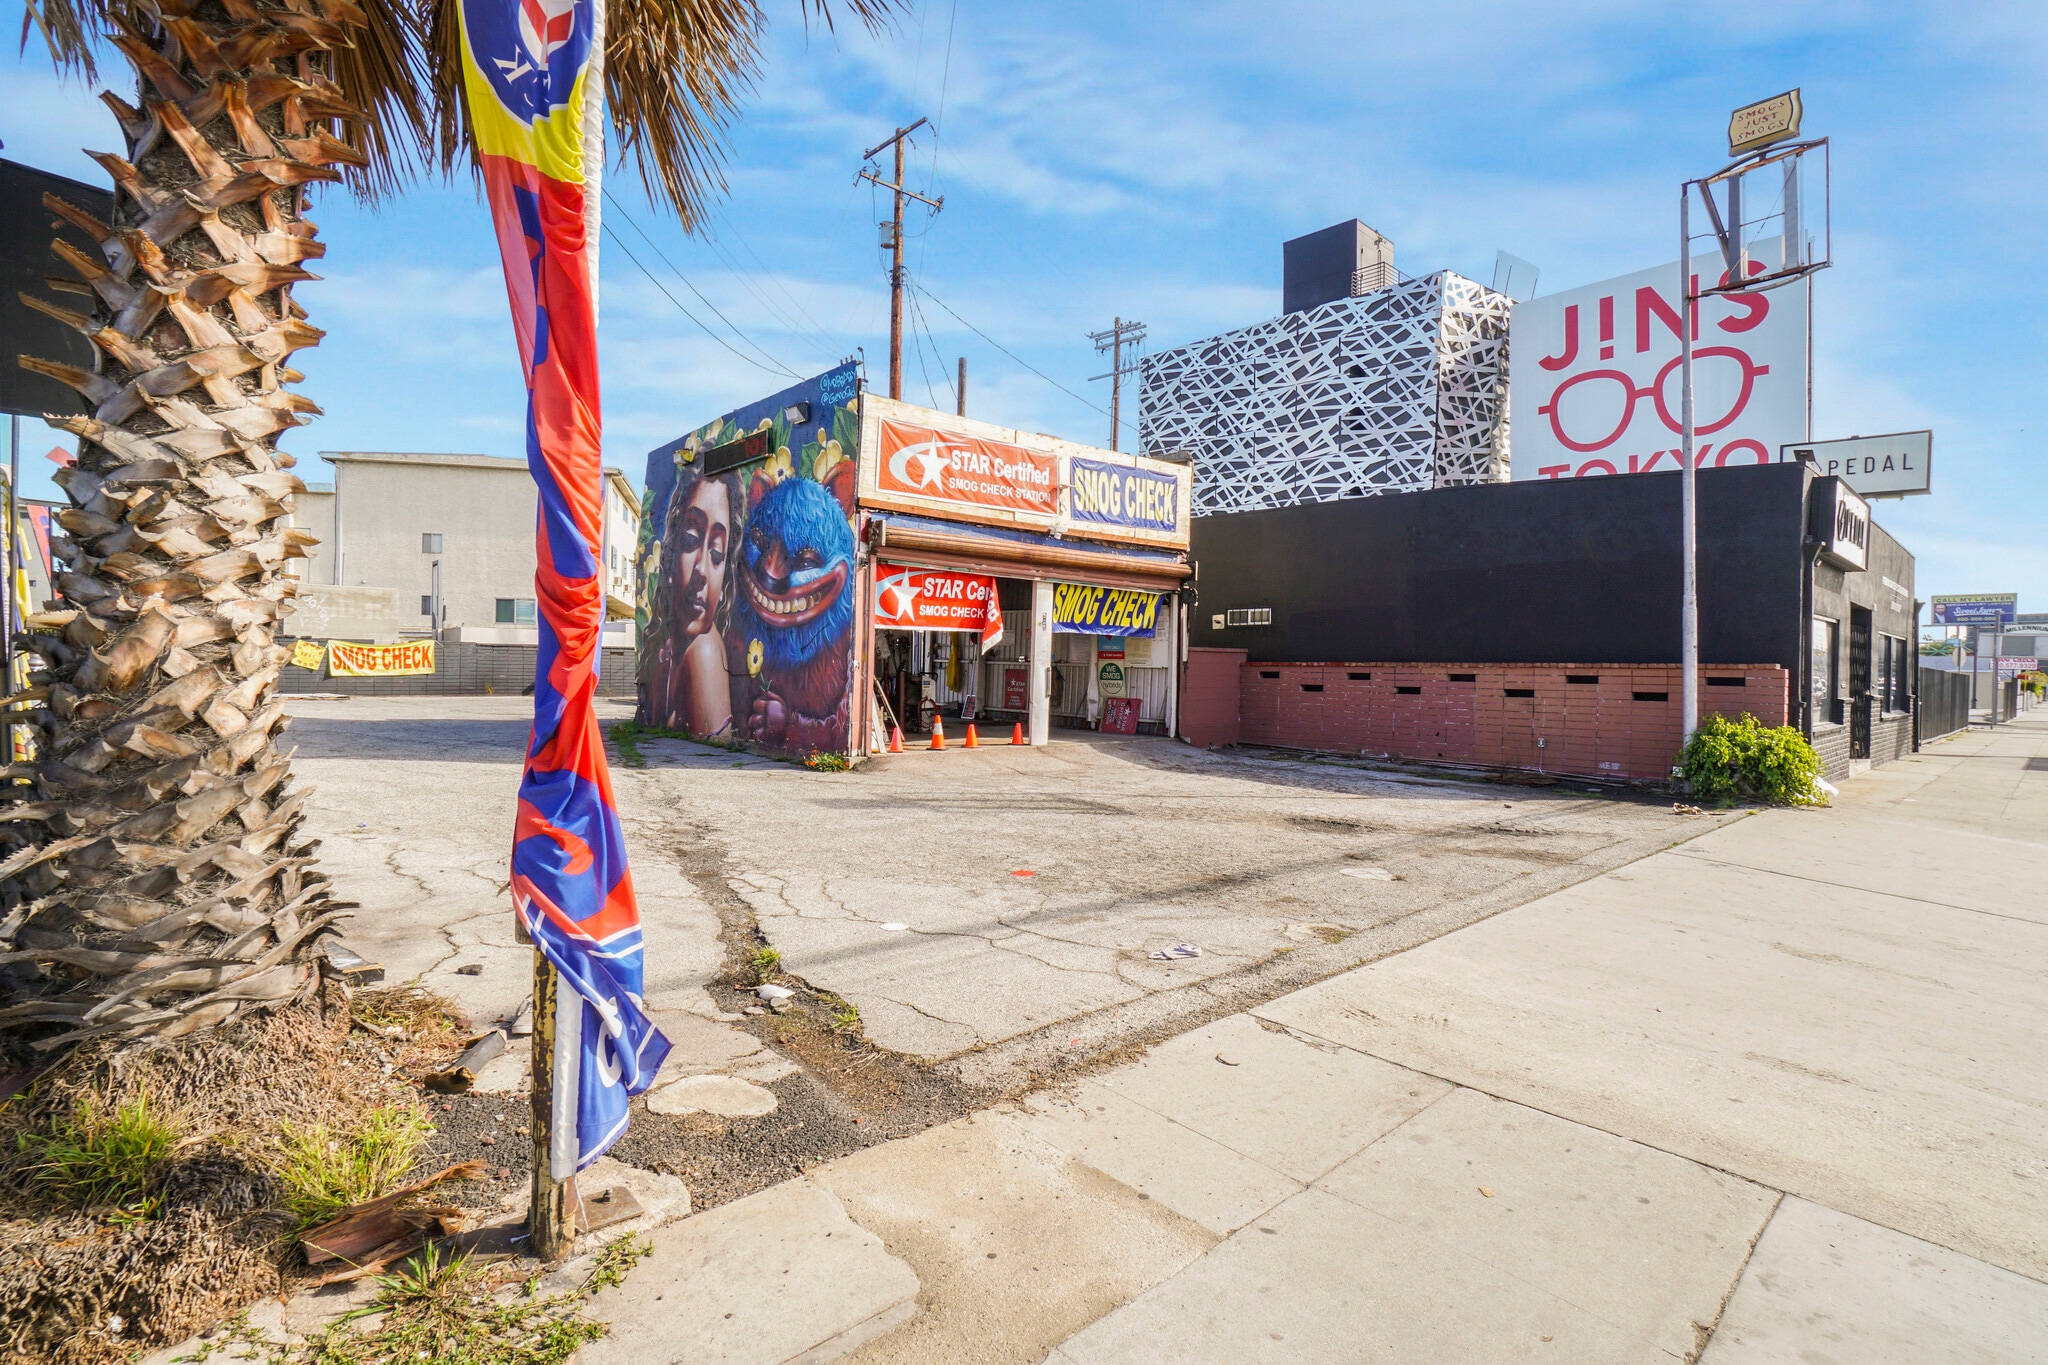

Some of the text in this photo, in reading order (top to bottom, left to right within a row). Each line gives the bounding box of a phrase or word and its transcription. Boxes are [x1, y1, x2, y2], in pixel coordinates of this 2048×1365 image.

[1738, 100, 1785, 122] SMOGS
[1744, 111, 1778, 129] JUST
[1737, 119, 1784, 141] SMOGS
[951, 449, 1050, 485] STAR Certified
[1828, 453, 1914, 477] PEDAL
[949, 477, 1051, 503] SMOG CHECK STATION
[1074, 467, 1175, 523] SMOG CHECK
[923, 577, 965, 600] STAR
[920, 604, 949, 617] SMOG
[950, 606, 985, 619] CHECK
[1053, 583, 1105, 625] SMOG
[1100, 589, 1160, 629] CHECK
[333, 645, 377, 671] SMOG
[381, 645, 433, 671] CHECK
[1106, 665, 1116, 673] WE
[1102, 672, 1121, 680] SMOG
[1102, 681, 1121, 689] hybrids
